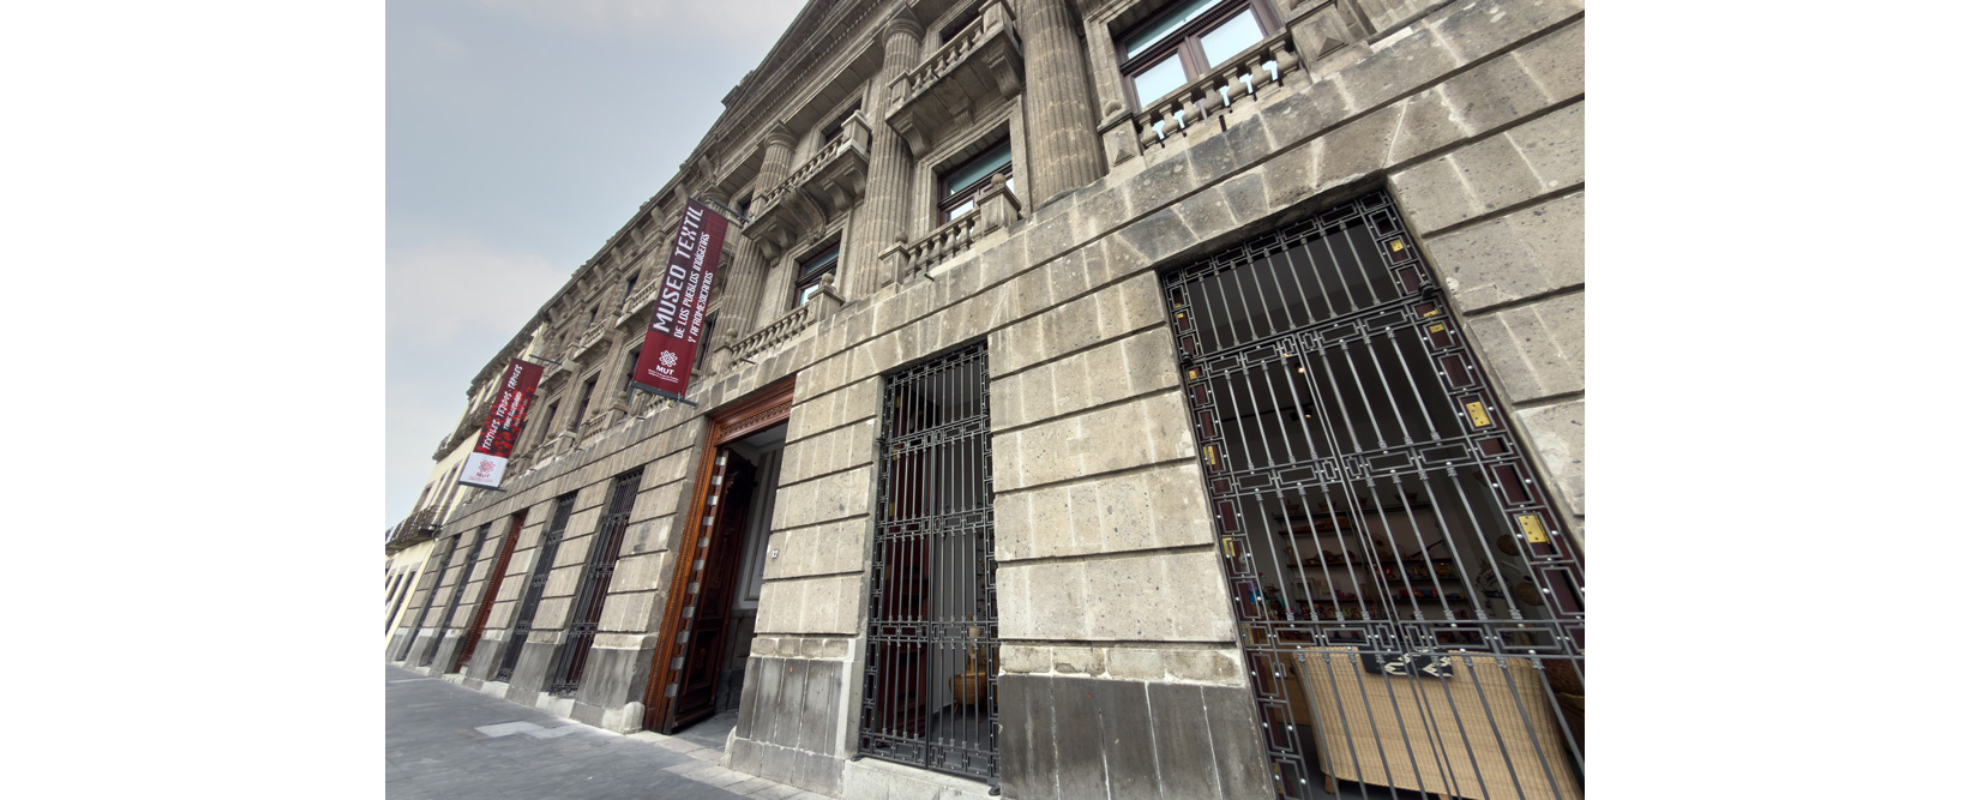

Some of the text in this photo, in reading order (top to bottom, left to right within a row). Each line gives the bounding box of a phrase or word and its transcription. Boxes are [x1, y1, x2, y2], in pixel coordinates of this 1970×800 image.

[653, 264, 686, 333] MUSEO
[674, 206, 704, 259] TEXTIL
[682, 271, 700, 307] PUEBLOS
[689, 270, 714, 336] AFROMEXICANOS
[673, 325, 685, 339] DE
[678, 307, 690, 326] LOS
[656, 365, 675, 375] MUT
[482, 419, 500, 450] TEXTILES
